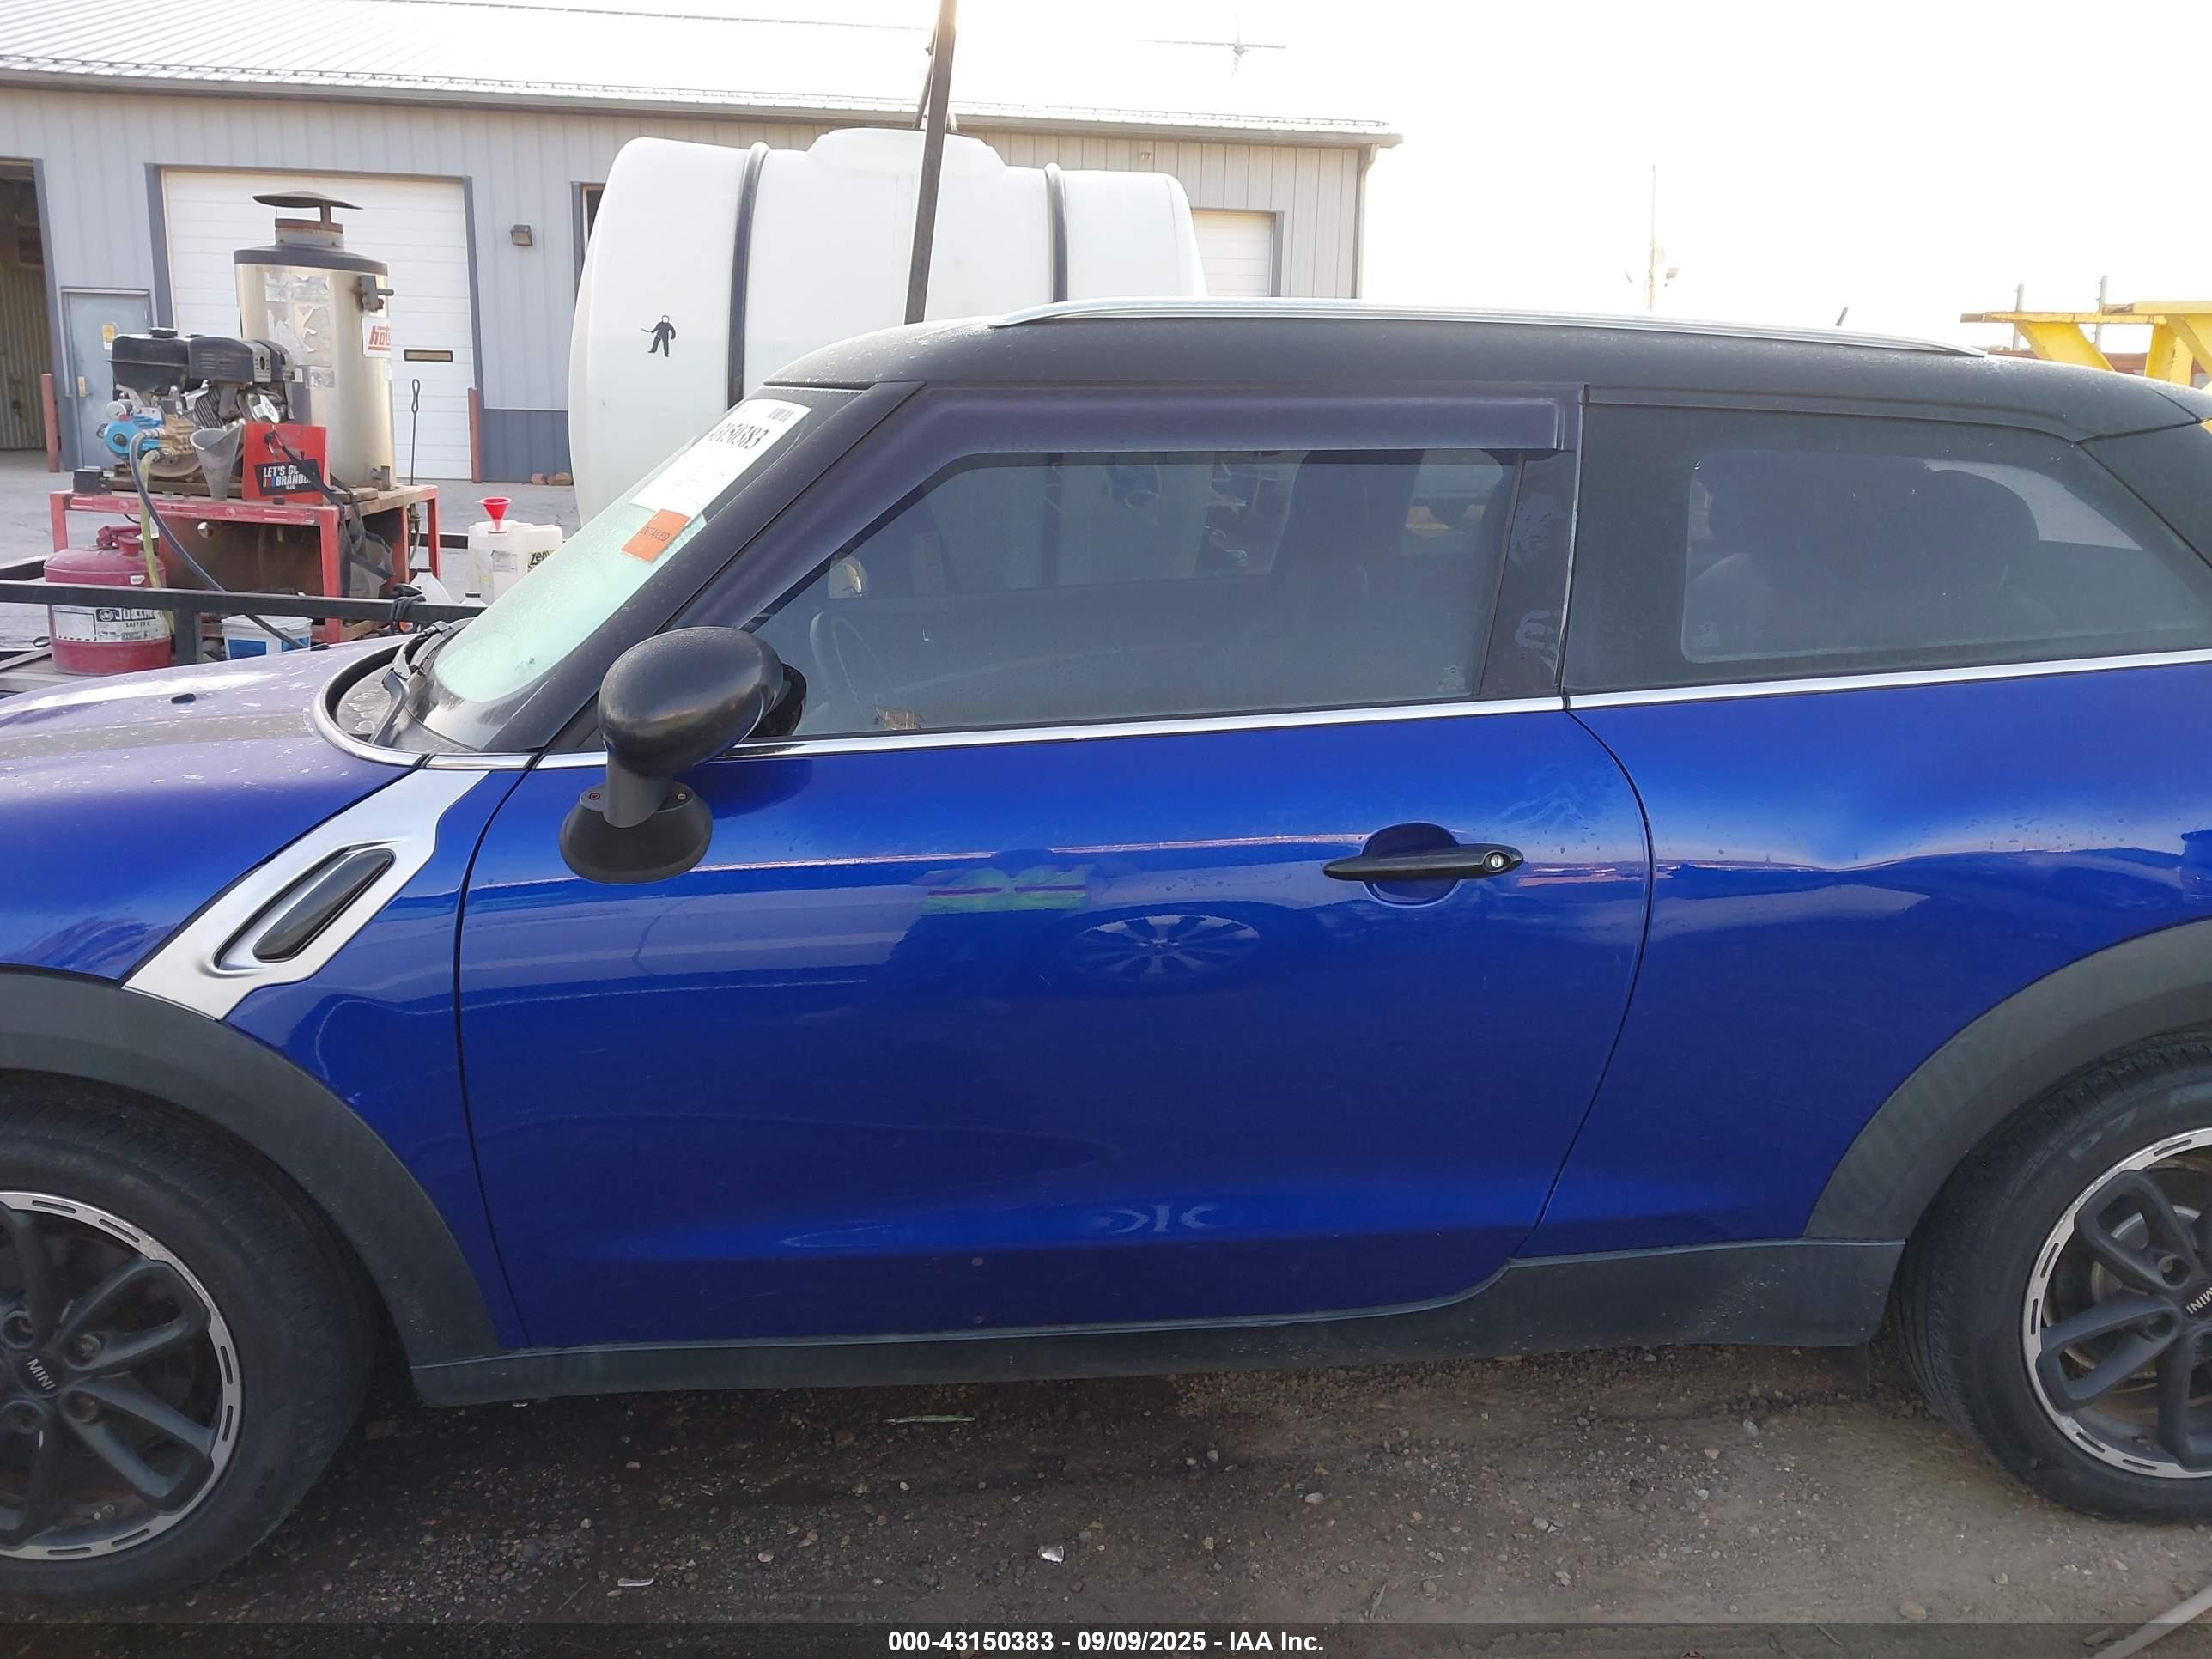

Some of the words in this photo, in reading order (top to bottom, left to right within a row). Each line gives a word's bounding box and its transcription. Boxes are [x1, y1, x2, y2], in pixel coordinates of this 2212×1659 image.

[263, 465, 286, 477] LET'S
[276, 473, 311, 487] BRAND
[27, 1358, 56, 1390] MINI
